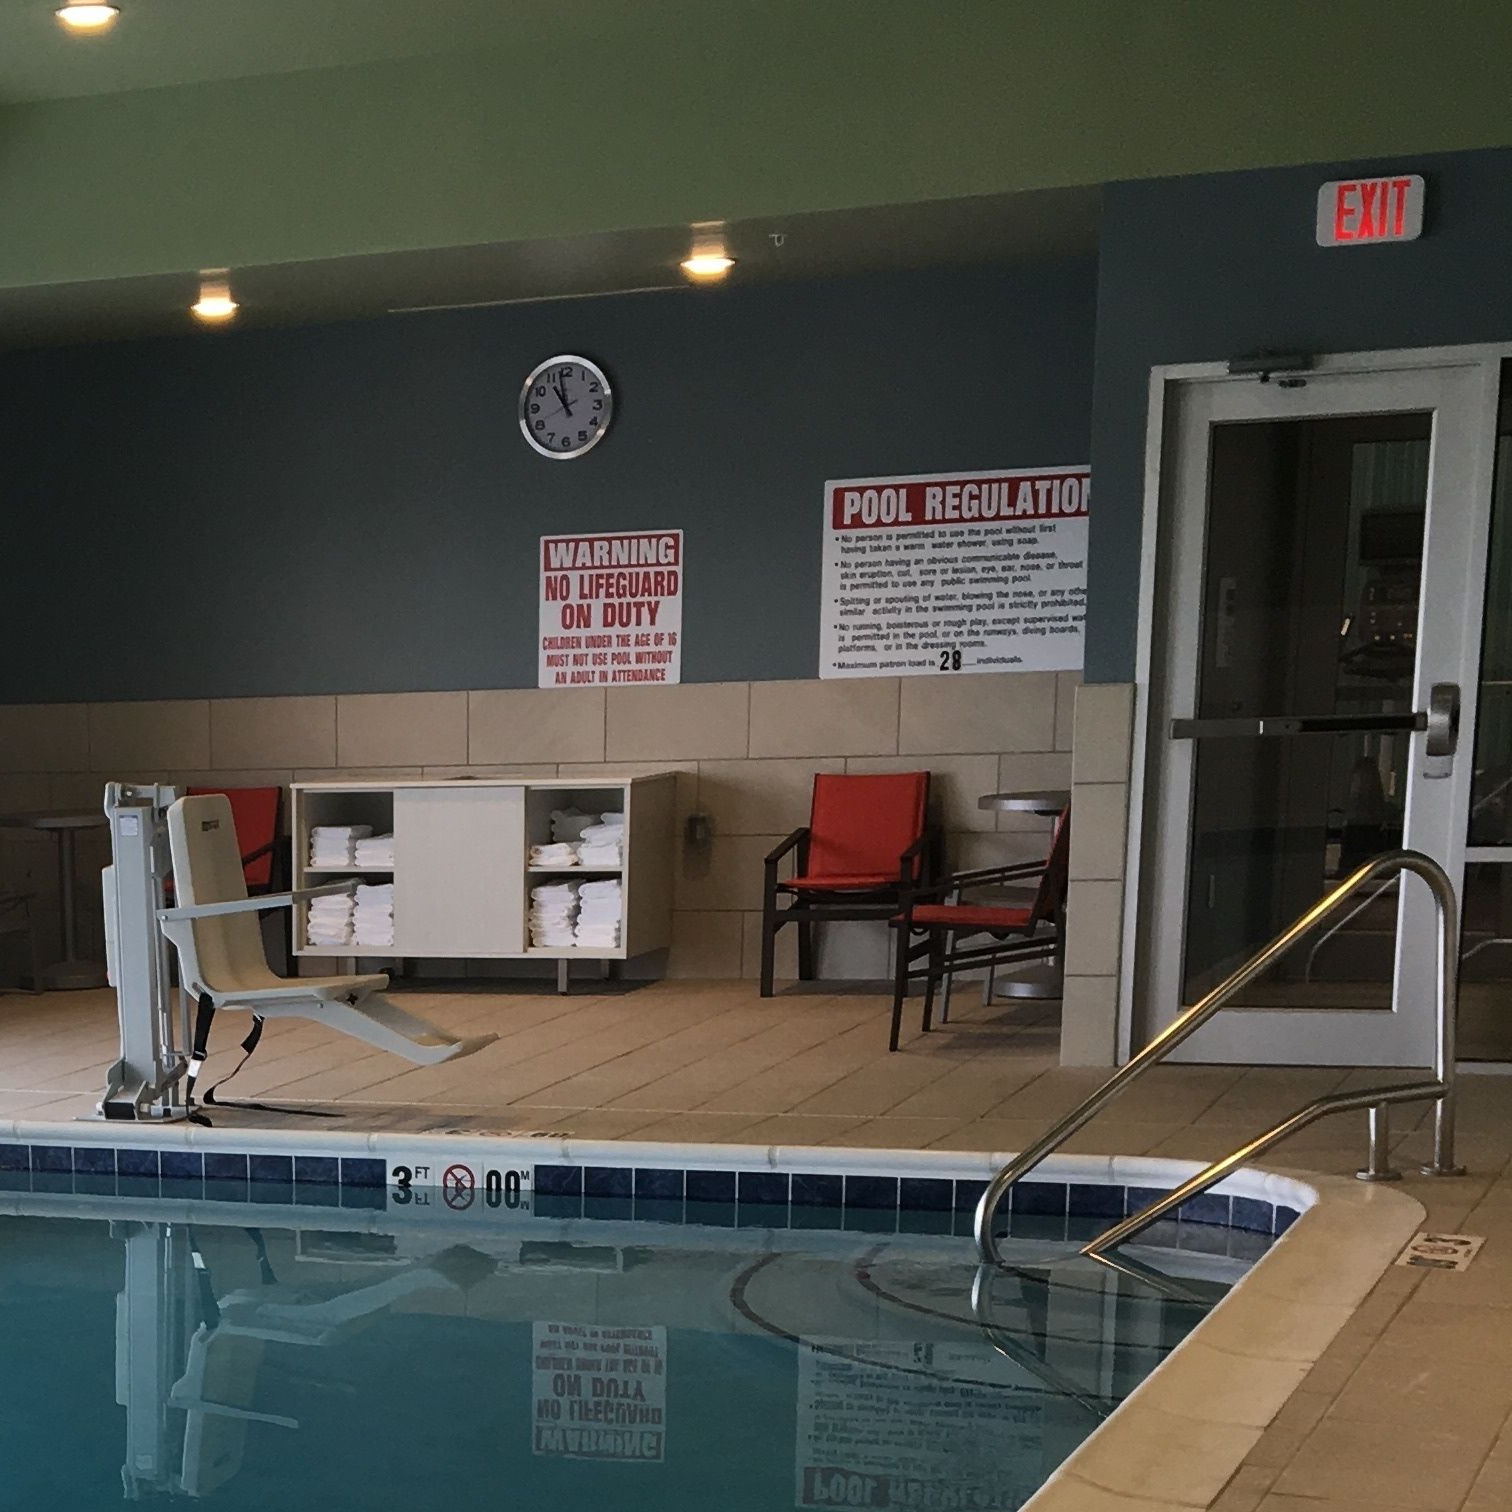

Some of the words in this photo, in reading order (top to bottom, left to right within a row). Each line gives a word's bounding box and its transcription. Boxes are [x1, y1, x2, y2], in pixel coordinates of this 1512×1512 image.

[1335, 179, 1411, 241] EXIT
[843, 488, 912, 525] POOL
[549, 536, 675, 569] WARNING
[545, 574, 570, 601] NO
[579, 570, 679, 600] LIFEGUARD
[561, 603, 591, 630] ON
[603, 600, 660, 628] DUTY
[542, 636, 582, 650] CHILDREN
[585, 634, 612, 648] UNDER
[616, 634, 631, 648] THE
[634, 633, 651, 647] AGE
[654, 632, 665, 646] OF
[546, 654, 569, 667] MUST
[573, 653, 589, 666] NOT
[592, 652, 608, 666] USE
[611, 652, 632, 665] POOL
[635, 650, 673, 665] WITHOUT
[940, 650, 962, 671] 28
[555, 671, 567, 684] AN
[570, 671, 595, 684] ADULT
[599, 670, 608, 682] IN
[611, 668, 666, 683] ATTENDANCE
